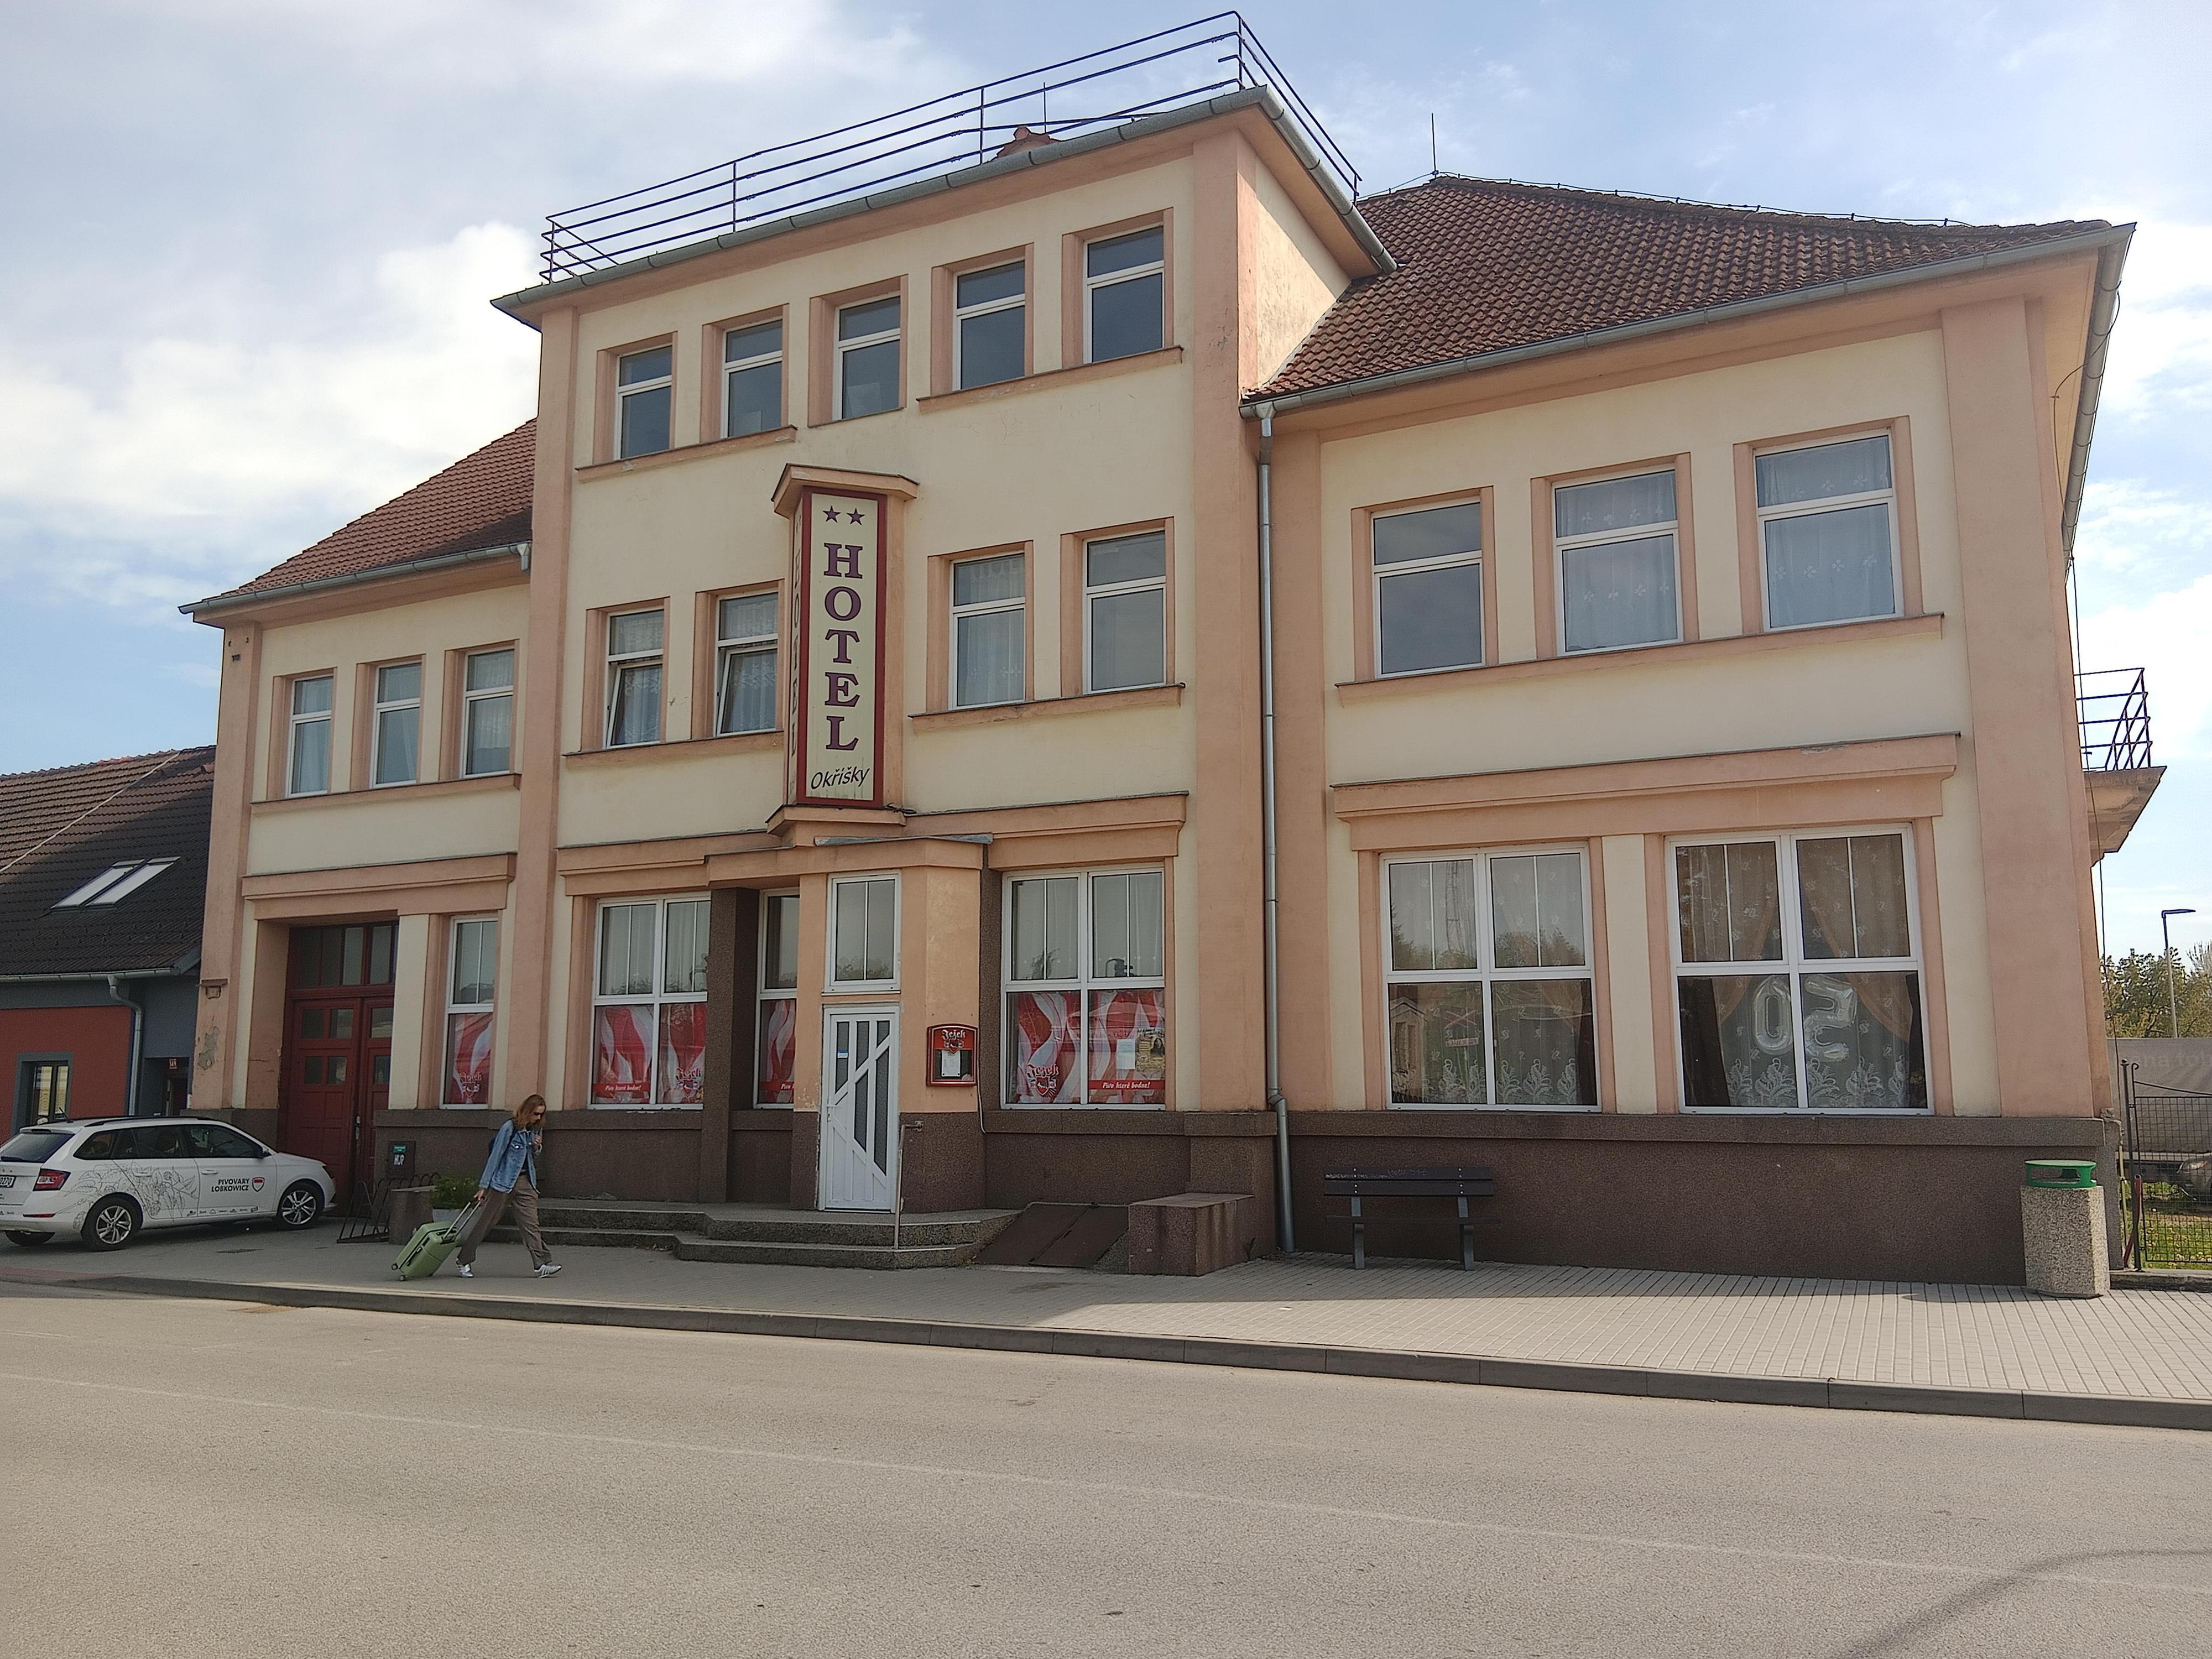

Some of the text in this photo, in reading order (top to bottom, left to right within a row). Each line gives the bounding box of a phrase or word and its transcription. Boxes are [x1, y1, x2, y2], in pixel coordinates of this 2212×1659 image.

[823, 542, 863, 752] HOTEL
[811, 766, 870, 790] Okříšky
[394, 1154, 405, 1166] HUP
